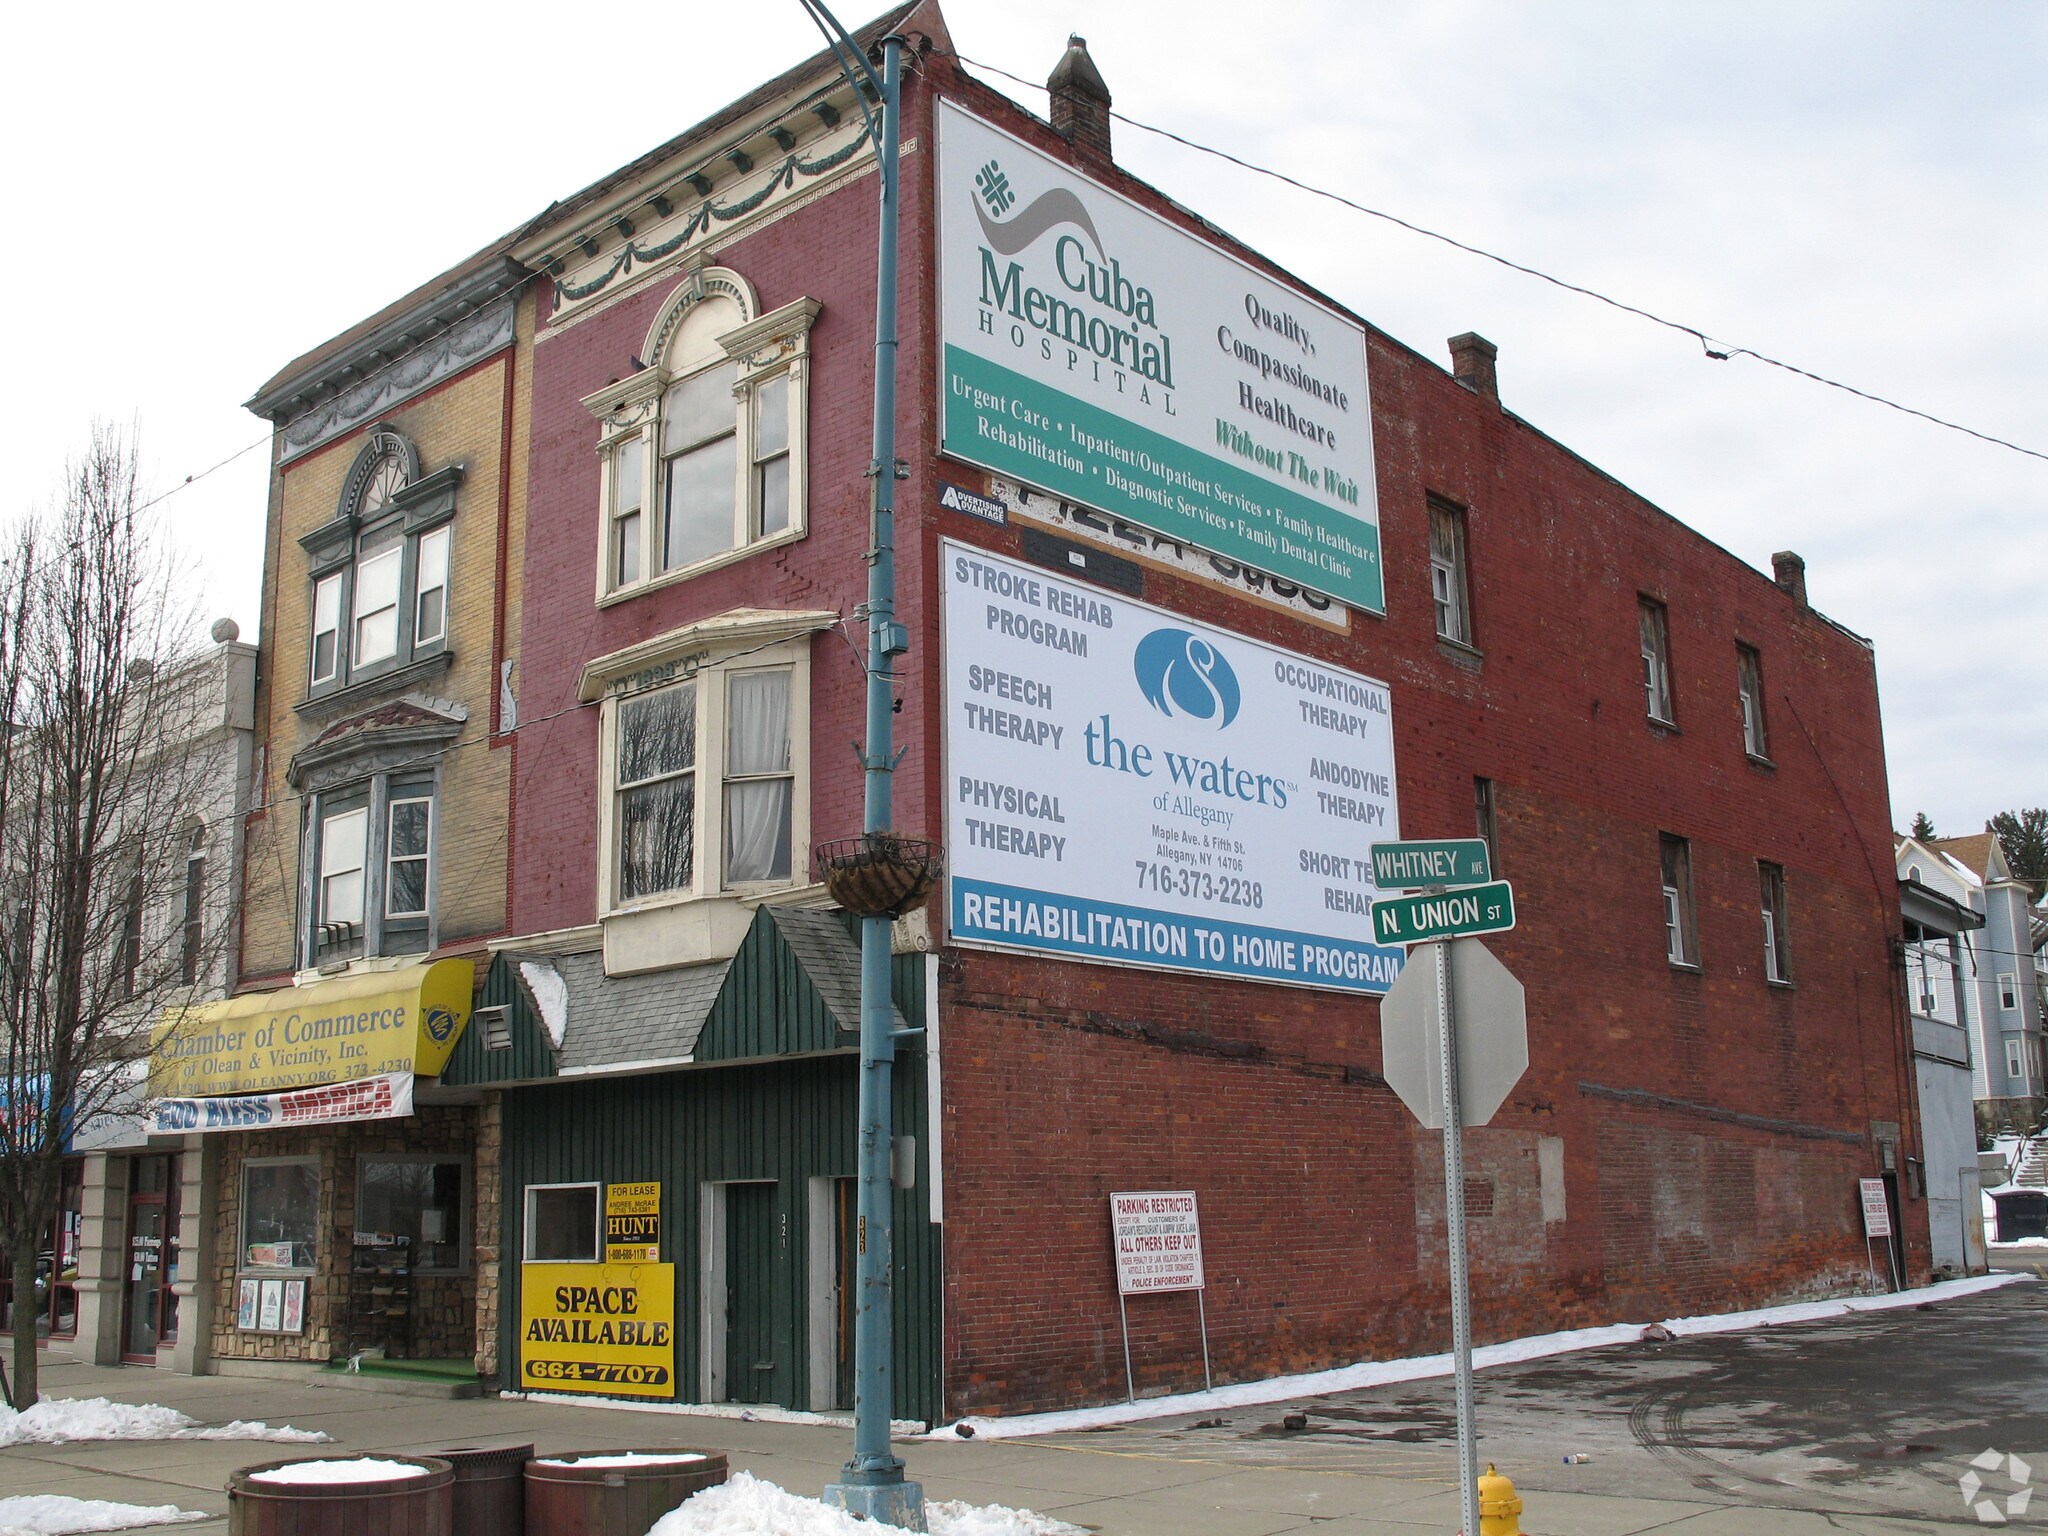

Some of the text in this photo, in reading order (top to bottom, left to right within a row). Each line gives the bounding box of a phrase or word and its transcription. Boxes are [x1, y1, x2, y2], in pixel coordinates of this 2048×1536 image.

[1055, 235, 1158, 330] Cuba
[977, 245, 1175, 390] Memorial
[1244, 293, 1316, 355] Quality,
[978, 308, 1177, 417] HOSPITAL
[1217, 325, 1349, 411] Compassionate
[1238, 380, 1336, 449] Healthcare
[952, 374, 1006, 414] Urgent
[1011, 399, 1050, 431] Care
[1070, 422, 1211, 497] Inpatient/Outpatient
[1215, 484, 1262, 518] Services
[1276, 508, 1314, 540] Family
[1317, 525, 1375, 564] Healthcare
[1215, 417, 1359, 506] Without The Wait
[978, 415, 1085, 475] Rehabilitation
[1105, 466, 1174, 510] Diagnostic
[1177, 495, 1227, 531] Services
[1238, 519, 1278, 554] Family
[1281, 536, 1318, 566] Dental
[1320, 553, 1352, 580] Clinic
[955, 556, 1113, 629] STROKE REHAB
[986, 604, 1088, 658] PROGRAM
[968, 664, 1052, 710] SPEECH
[1274, 660, 1387, 715] OCCUPATIONAL
[964, 701, 1064, 750] THERAPY
[1299, 700, 1367, 739] THERAPY
[1083, 714, 1153, 777] the
[1163, 750, 1288, 809] waters
[1309, 757, 1389, 797] ANDODYNE
[959, 775, 1066, 824] PHYSICAL
[1153, 791, 1234, 831] of Allegany
[1317, 791, 1385, 827] THERAPY
[965, 818, 1066, 862] THERAPY
[1151, 823, 1246, 855] Maple Ave. & Fifth St.
[1156, 843, 1243, 872] Allegany, NY 14706
[1135, 860, 1263, 909] 716-373-2238
[1299, 848, 1374, 885] SHORT TE
[1375, 850, 1484, 879] WHITNEY AVE
[1381, 896, 1501, 935] N. UNION ST
[963, 891, 1399, 984] REHABILITATION TO HOME PROGRAM
[159, 1025, 246, 1060] Chamber
[255, 1018, 277, 1049] of
[284, 1006, 406, 1045] Commerce
[183, 1041, 369, 1077] of Olean & Vicinity, Inc.
[208, 1069, 336, 1093] WWW.OLEANNY.ORG
[157, 1100, 199, 1131] GOD
[205, 1097, 273, 1127] BLESS
[279, 1077, 393, 1121] AMERICA
[612, 1186, 656, 1197] FOR LEASE
[1117, 1197, 1193, 1214] PARKING RESTRICTED
[607, 1216, 657, 1235] HUNT
[1147, 1216, 1178, 1224] CUSTOMERS
[275, 1256, 292, 1265] SHOP
[276, 1248, 290, 1257] GIFT
[1120, 1234, 1197, 1253] ALL OTHERS KEEP OUT
[555, 1285, 638, 1314] SPACE
[1131, 1275, 1194, 1288] POLICE ENFORCEMENT
[526, 1318, 670, 1346] AVAILABLE
[531, 1361, 660, 1383] 664-7707
